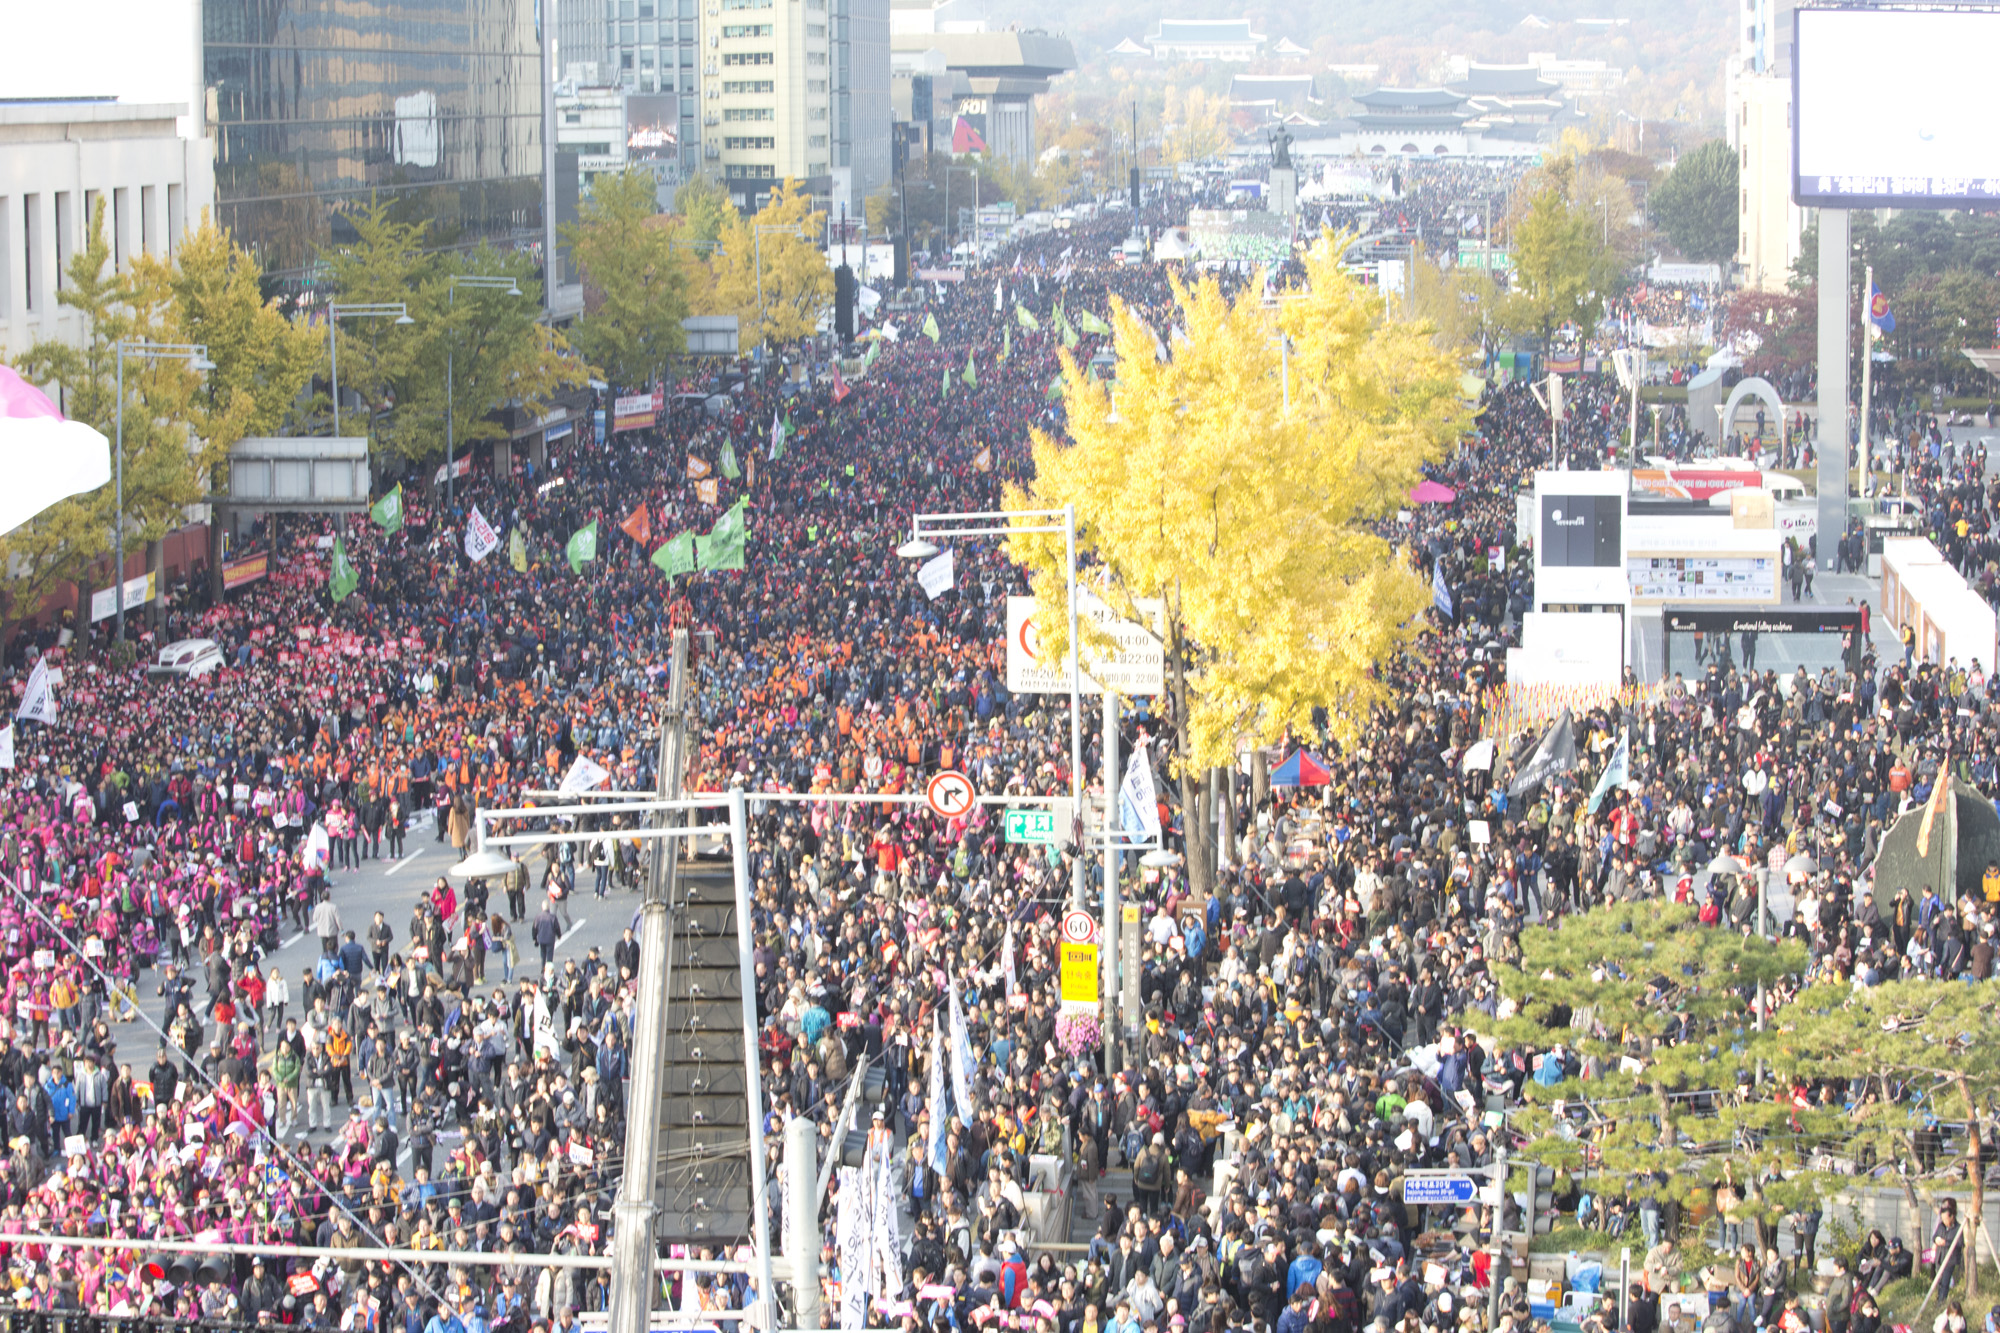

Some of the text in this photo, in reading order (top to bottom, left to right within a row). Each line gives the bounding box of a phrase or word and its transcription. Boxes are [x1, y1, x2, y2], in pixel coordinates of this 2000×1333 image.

[1182, 907, 1202, 915] Parking
[1069, 920, 1088, 934] 60
[267, 1166, 280, 1180] 10
